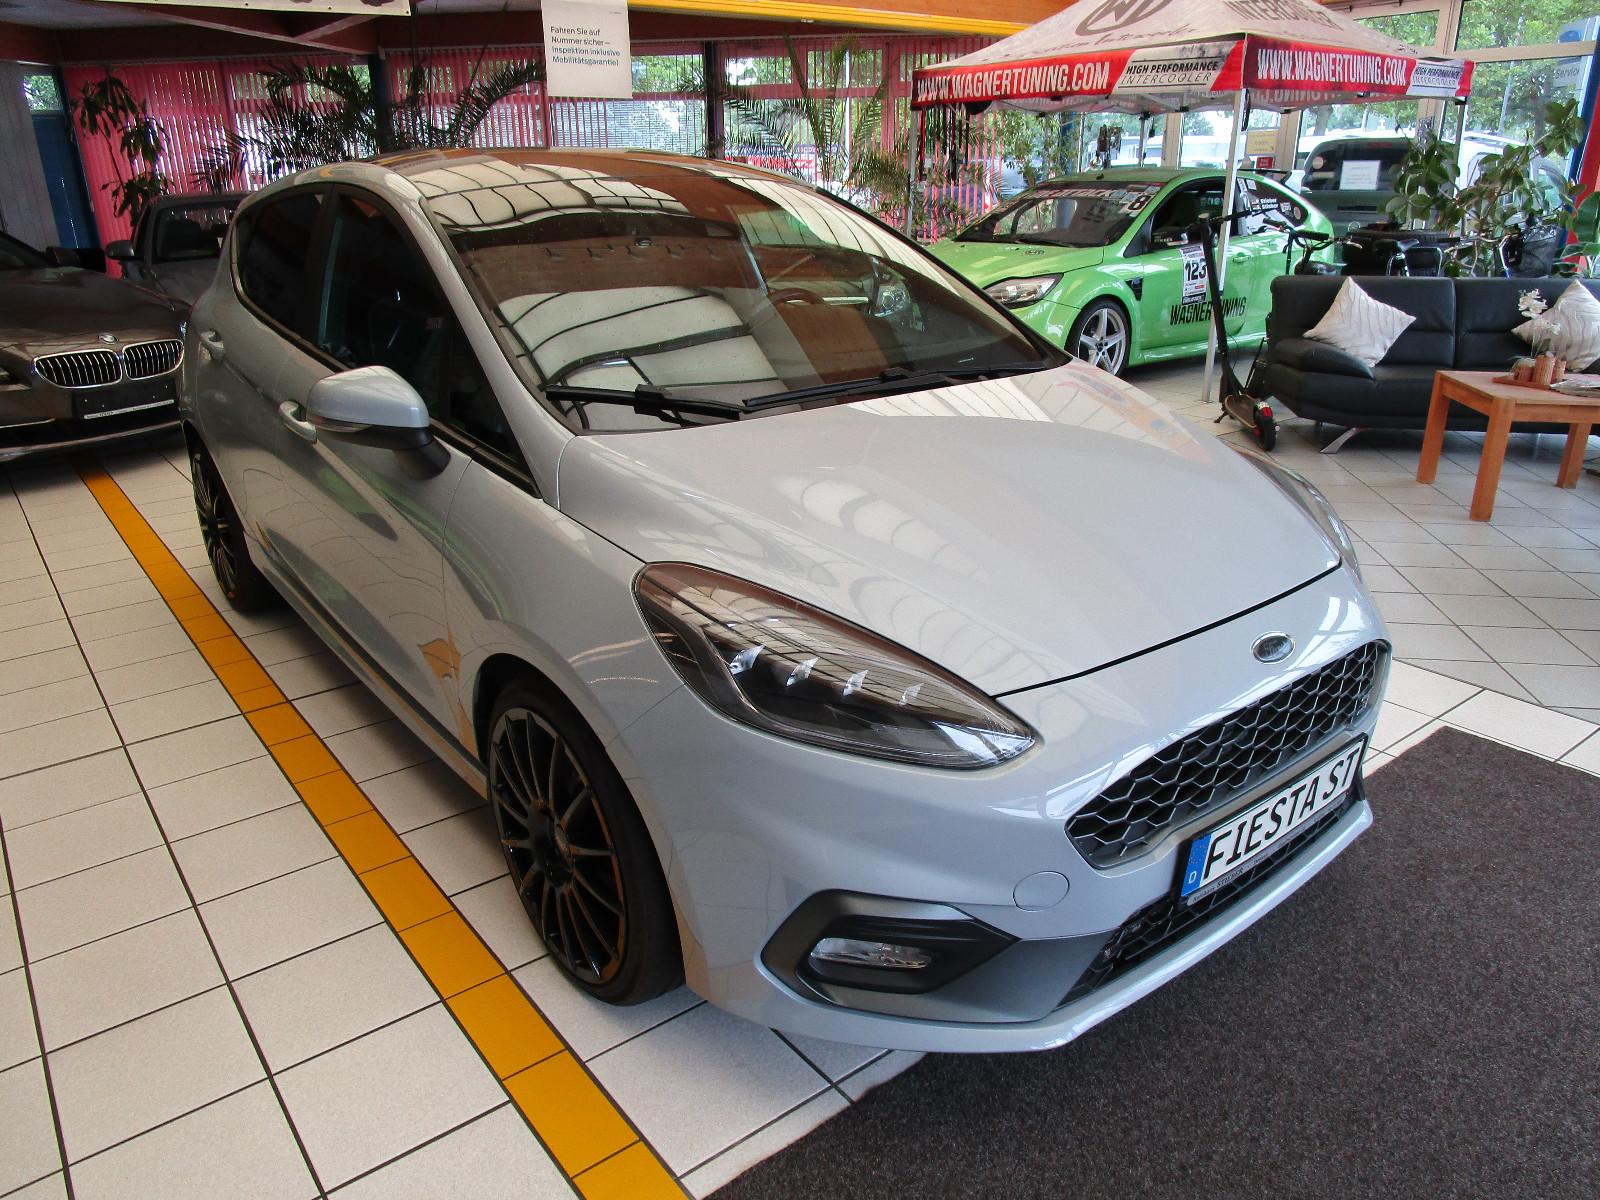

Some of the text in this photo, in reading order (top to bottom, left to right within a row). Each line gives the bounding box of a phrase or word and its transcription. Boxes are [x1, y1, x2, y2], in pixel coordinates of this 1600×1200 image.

[550, 26, 601, 36] Fahren Sie auf
[551, 36, 582, 45] Nummer
[583, 38, 604, 46] sicher
[552, 46, 621, 57] Inspektion inklusive
[1126, 61, 1219, 75] HIGH PERFORMANCE
[1257, 48, 1407, 86] WWW.WAGNERTUNING.COM
[917, 62, 1111, 102] WWW.WAGNERTUNING.COM
[1121, 72, 1212, 85] INTERCOOLER
[1185, 258, 1207, 281] 123
[1170, 296, 1247, 326] WAGNERNING
[1203, 746, 1360, 880] FIESTA ST
[1188, 870, 1197, 884] D
